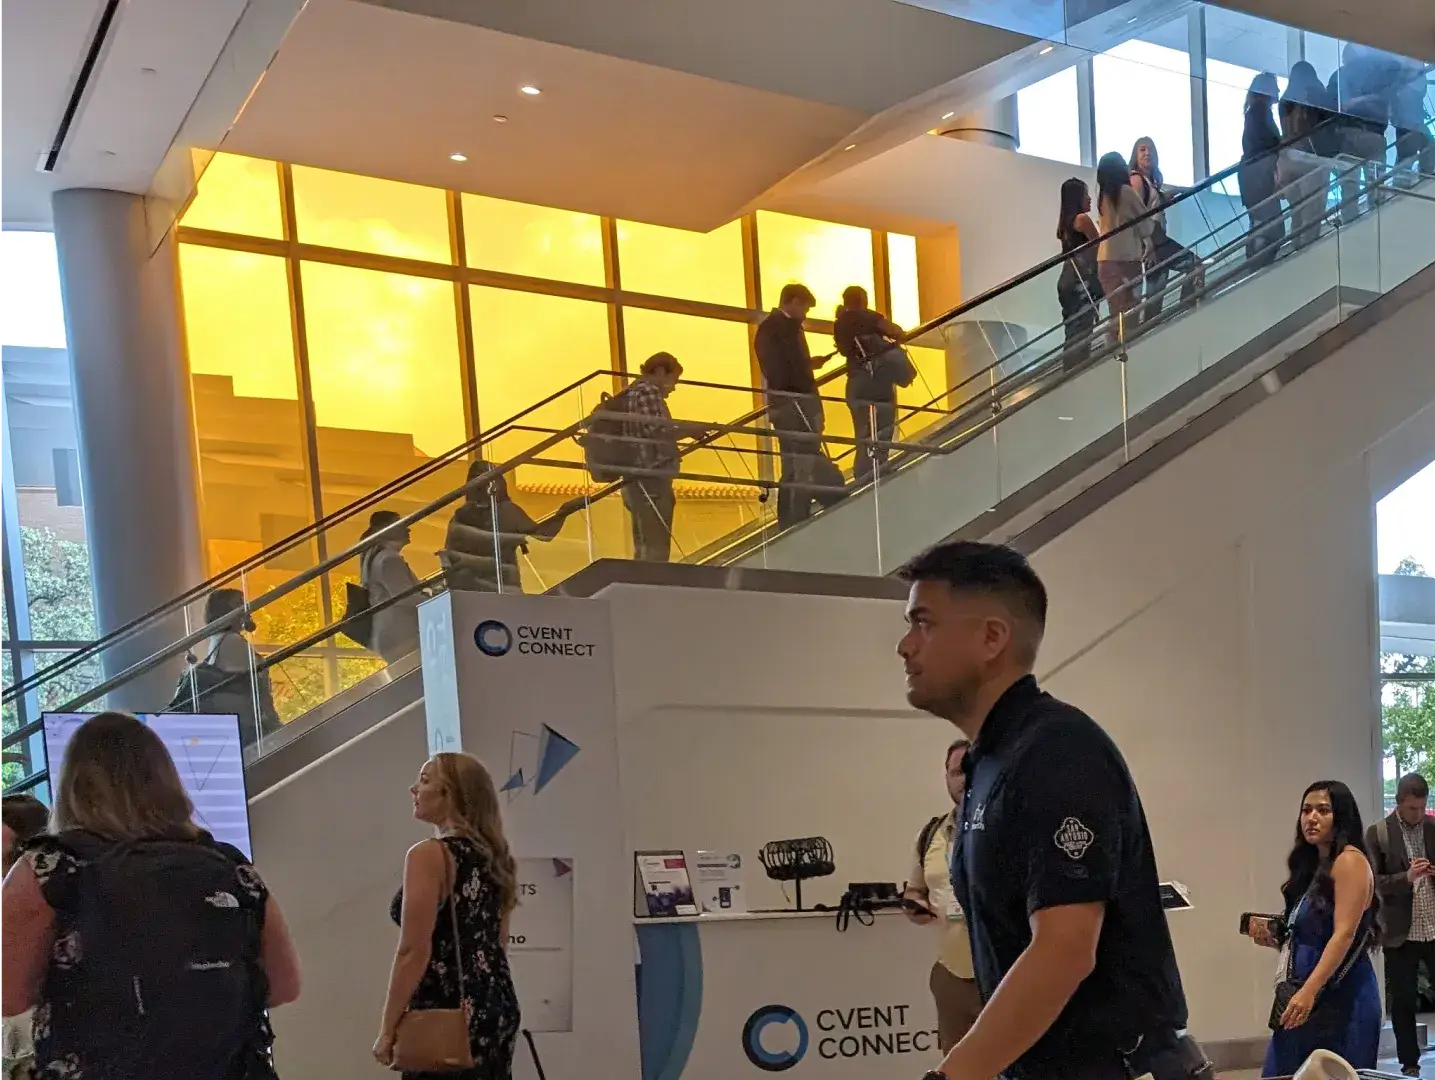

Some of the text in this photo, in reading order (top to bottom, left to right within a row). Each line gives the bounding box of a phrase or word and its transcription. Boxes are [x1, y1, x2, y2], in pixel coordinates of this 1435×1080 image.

[517, 626, 573, 640] CVENT
[518, 642, 596, 656] CONNECT
[816, 1004, 909, 1031] CVENT
[818, 1029, 942, 1059] CONNECT
